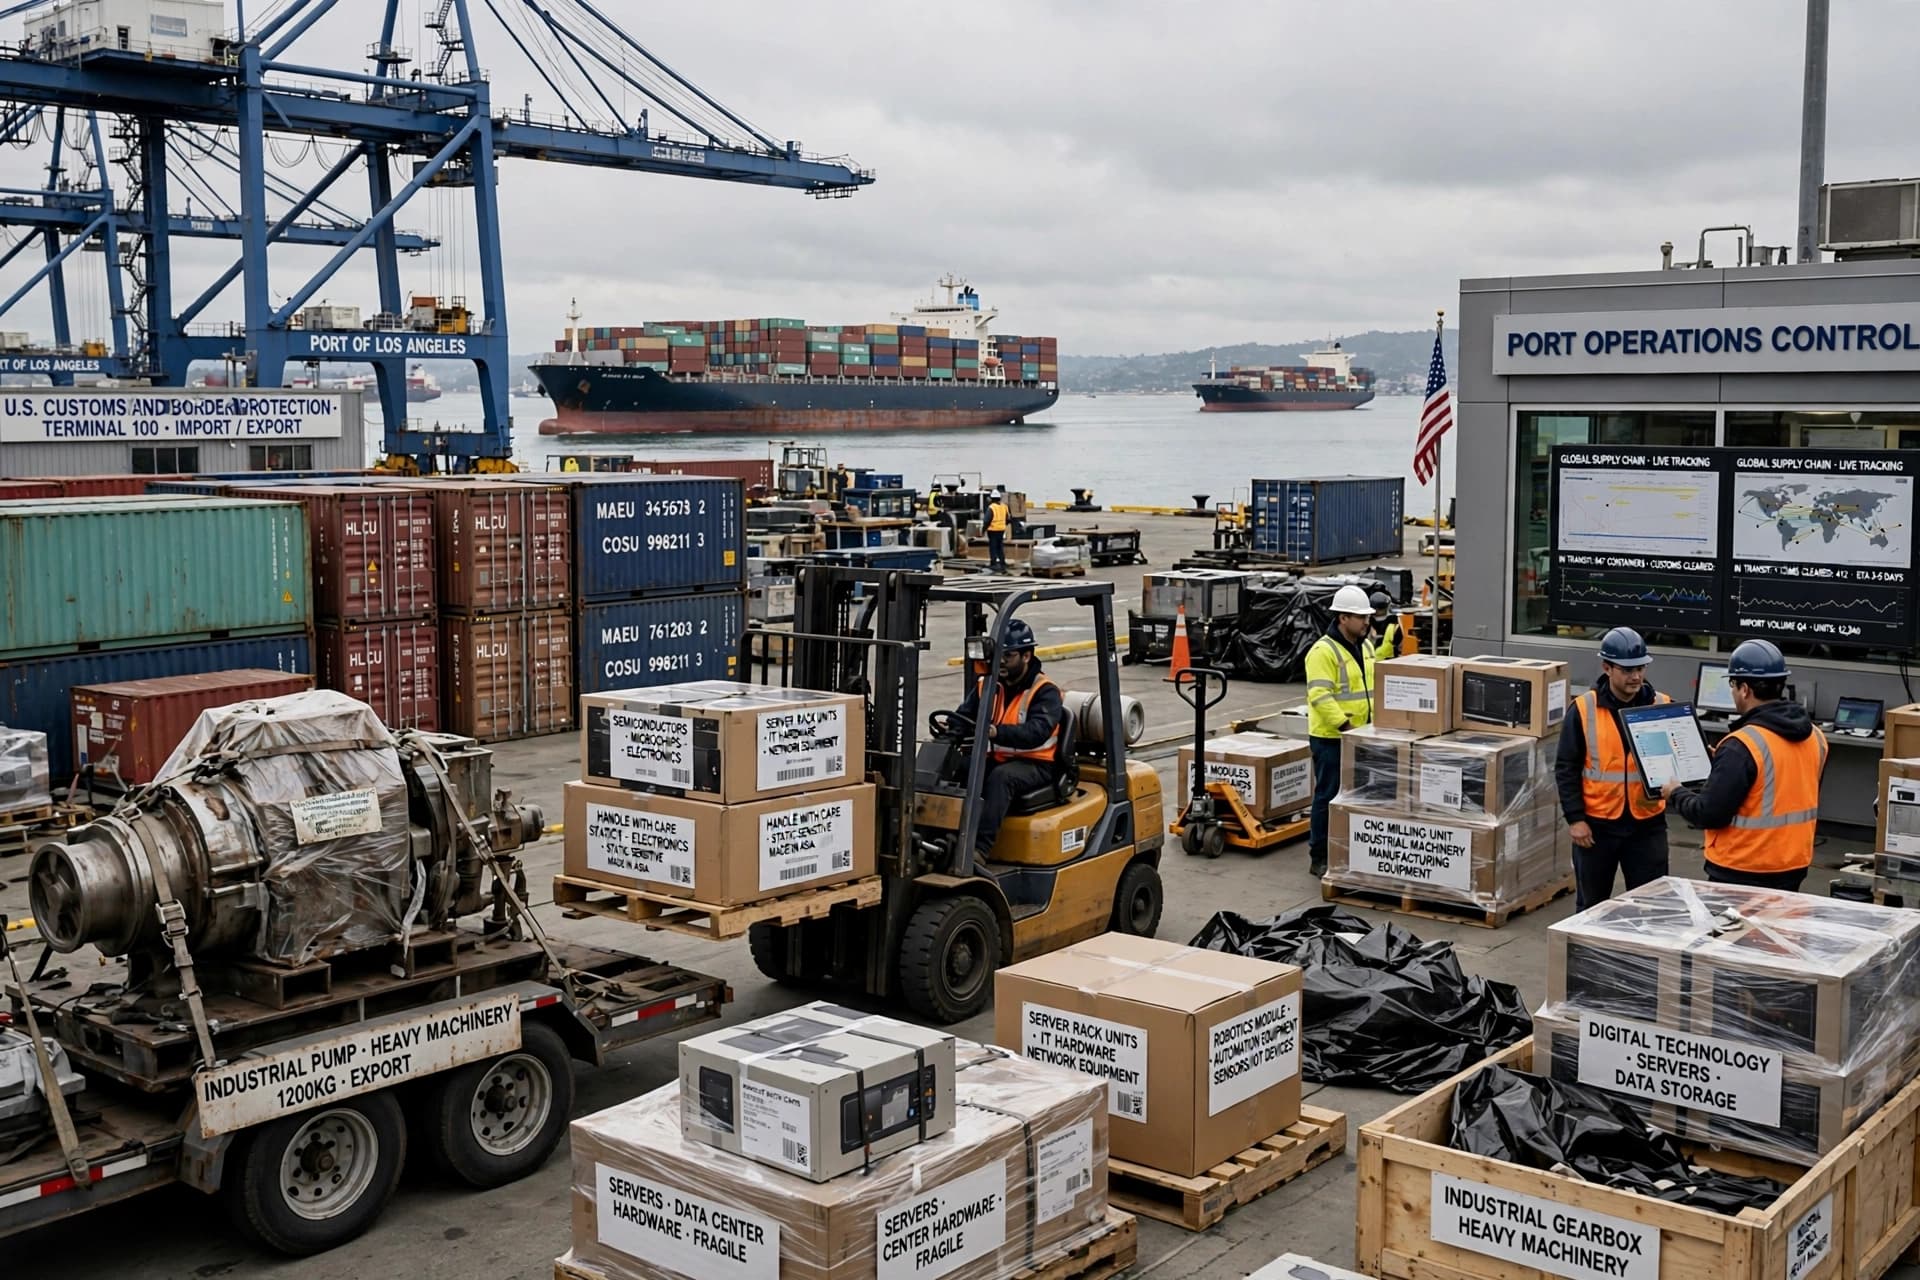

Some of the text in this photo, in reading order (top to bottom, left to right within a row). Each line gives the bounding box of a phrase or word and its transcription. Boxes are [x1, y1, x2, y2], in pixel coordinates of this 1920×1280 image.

[310, 334, 466, 355] PORT OF LOS ANGELES
[1507, 322, 1920, 357] PORT OPERATIONS CONTROL
[13, 359, 27, 371] OF
[30, 359, 50, 371] LOS
[53, 359, 100, 371] ANGELES
[5, 398, 38, 416] U.S.
[43, 398, 126, 416] CUSTOMS
[131, 398, 171, 416] AND
[42, 420, 126, 437] TERMINAL
[132, 420, 159, 436] 100
[175, 419, 231, 436] IMPORT
[247, 418, 302, 435] EXPORT
[1560, 454, 1711, 467] GLOBAL SUPPLY CHAIN LIVE TRACKING
[1737, 458, 1904, 471] GLOBAL SUPPLY CHAIN LIVE TRACKING
[597, 501, 635, 519] MAEU
[698, 499, 706, 515] 2
[602, 532, 705, 554] COSU 998211 3
[1884, 572, 1904, 582] DAYS
[602, 626, 639, 645] MAEU
[649, 621, 693, 640] 761203
[700, 620, 708, 635] 2
[605, 652, 703, 678] COSU 998211 3
[613, 714, 688, 736] SEMICONDUCTORS
[1210, 765, 1250, 779] MODULES
[597, 810, 677, 835] HANDLE WITH CARE
[1364, 819, 1454, 841] CNC MILLING UNIT
[1354, 831, 1466, 857] INDUSTRIAL MACHINERY
[1368, 846, 1450, 869] MANUFACTURING
[1029, 1010, 1138, 1049] SERVER RACK UNITS
[1213, 1018, 1254, 1048] ROBOTICS
[204, 1002, 513, 1102] INDUSTRIAL PUMP HEAVY MACHINERY
[1041, 1031, 1116, 1063] IT HARDWARE
[1589, 1021, 1770, 1073] DIGITAL TECHNOLOGY
[1027, 1045, 1140, 1085] NETWORK EQUIPMENT
[1636, 1052, 1710, 1083] SERVERS
[277, 1053, 411, 1109] 1200KG EXPORT
[1615, 1069, 1737, 1111] DATA STORAGE
[609, 1176, 764, 1245] SERVERS DATA CENTER
[884, 1197, 939, 1237] SERVERS
[1444, 1185, 1642, 1255] INDUSTRIAL GEARBOX
[613, 1200, 747, 1263] HARDWARE FRAGILE
[883, 1193, 996, 1261] CENTER HARDWARE
[916, 1232, 964, 1271] FRAGILE
[1459, 1215, 1629, 1278] HEAVY MACHINERY
